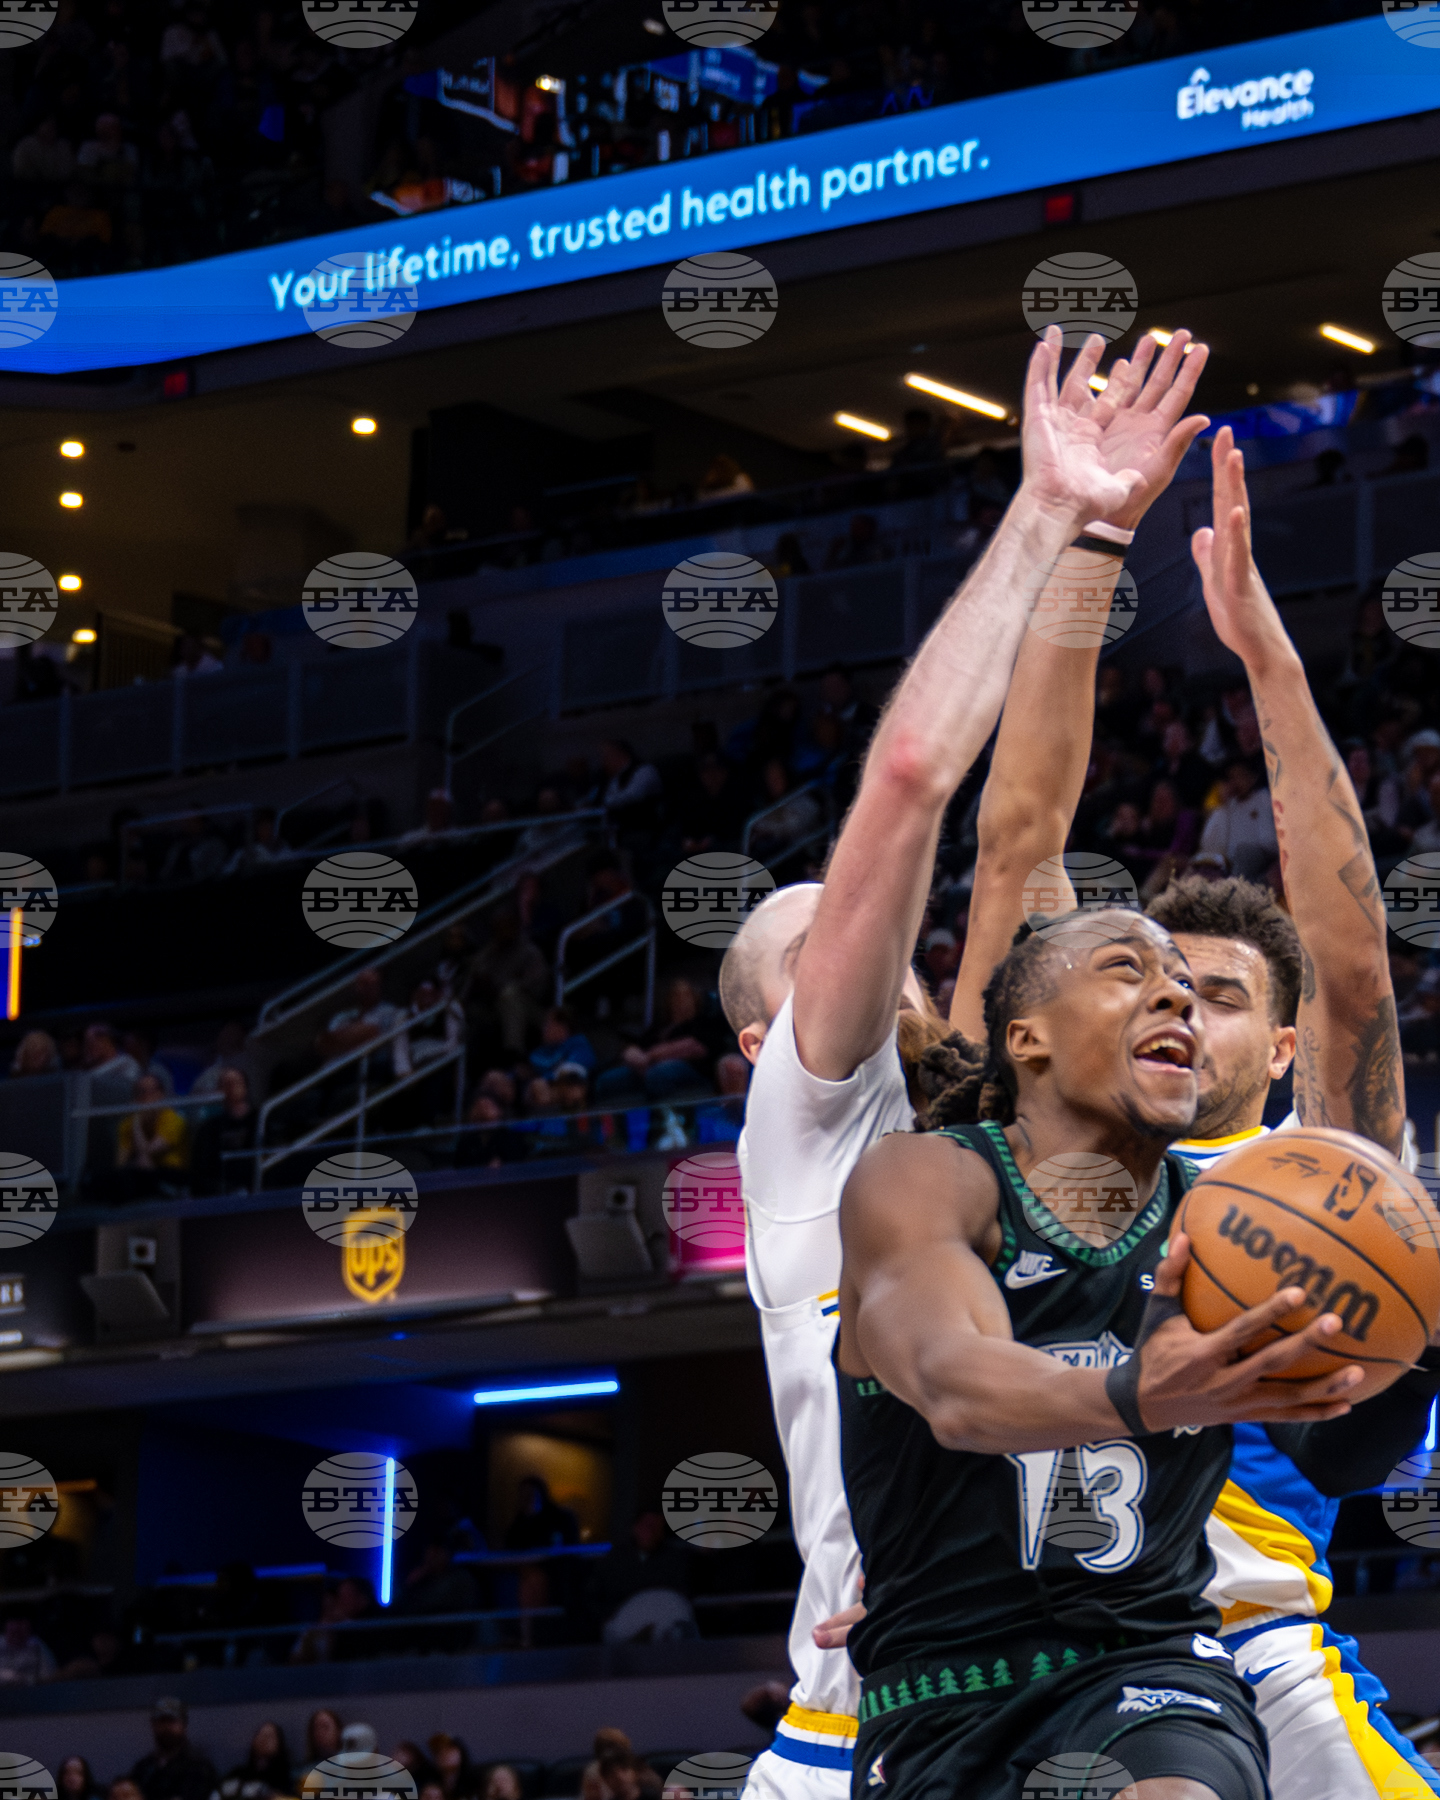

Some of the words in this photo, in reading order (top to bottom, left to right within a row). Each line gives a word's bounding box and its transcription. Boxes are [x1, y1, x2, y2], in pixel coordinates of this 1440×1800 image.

[269, 268, 356, 311] Your
[365, 235, 520, 291] lifetime,
[528, 192, 672, 259] trusted
[681, 166, 810, 230] health
[821, 138, 990, 213] partner.
[1016, 1250, 1053, 1275] NIKE
